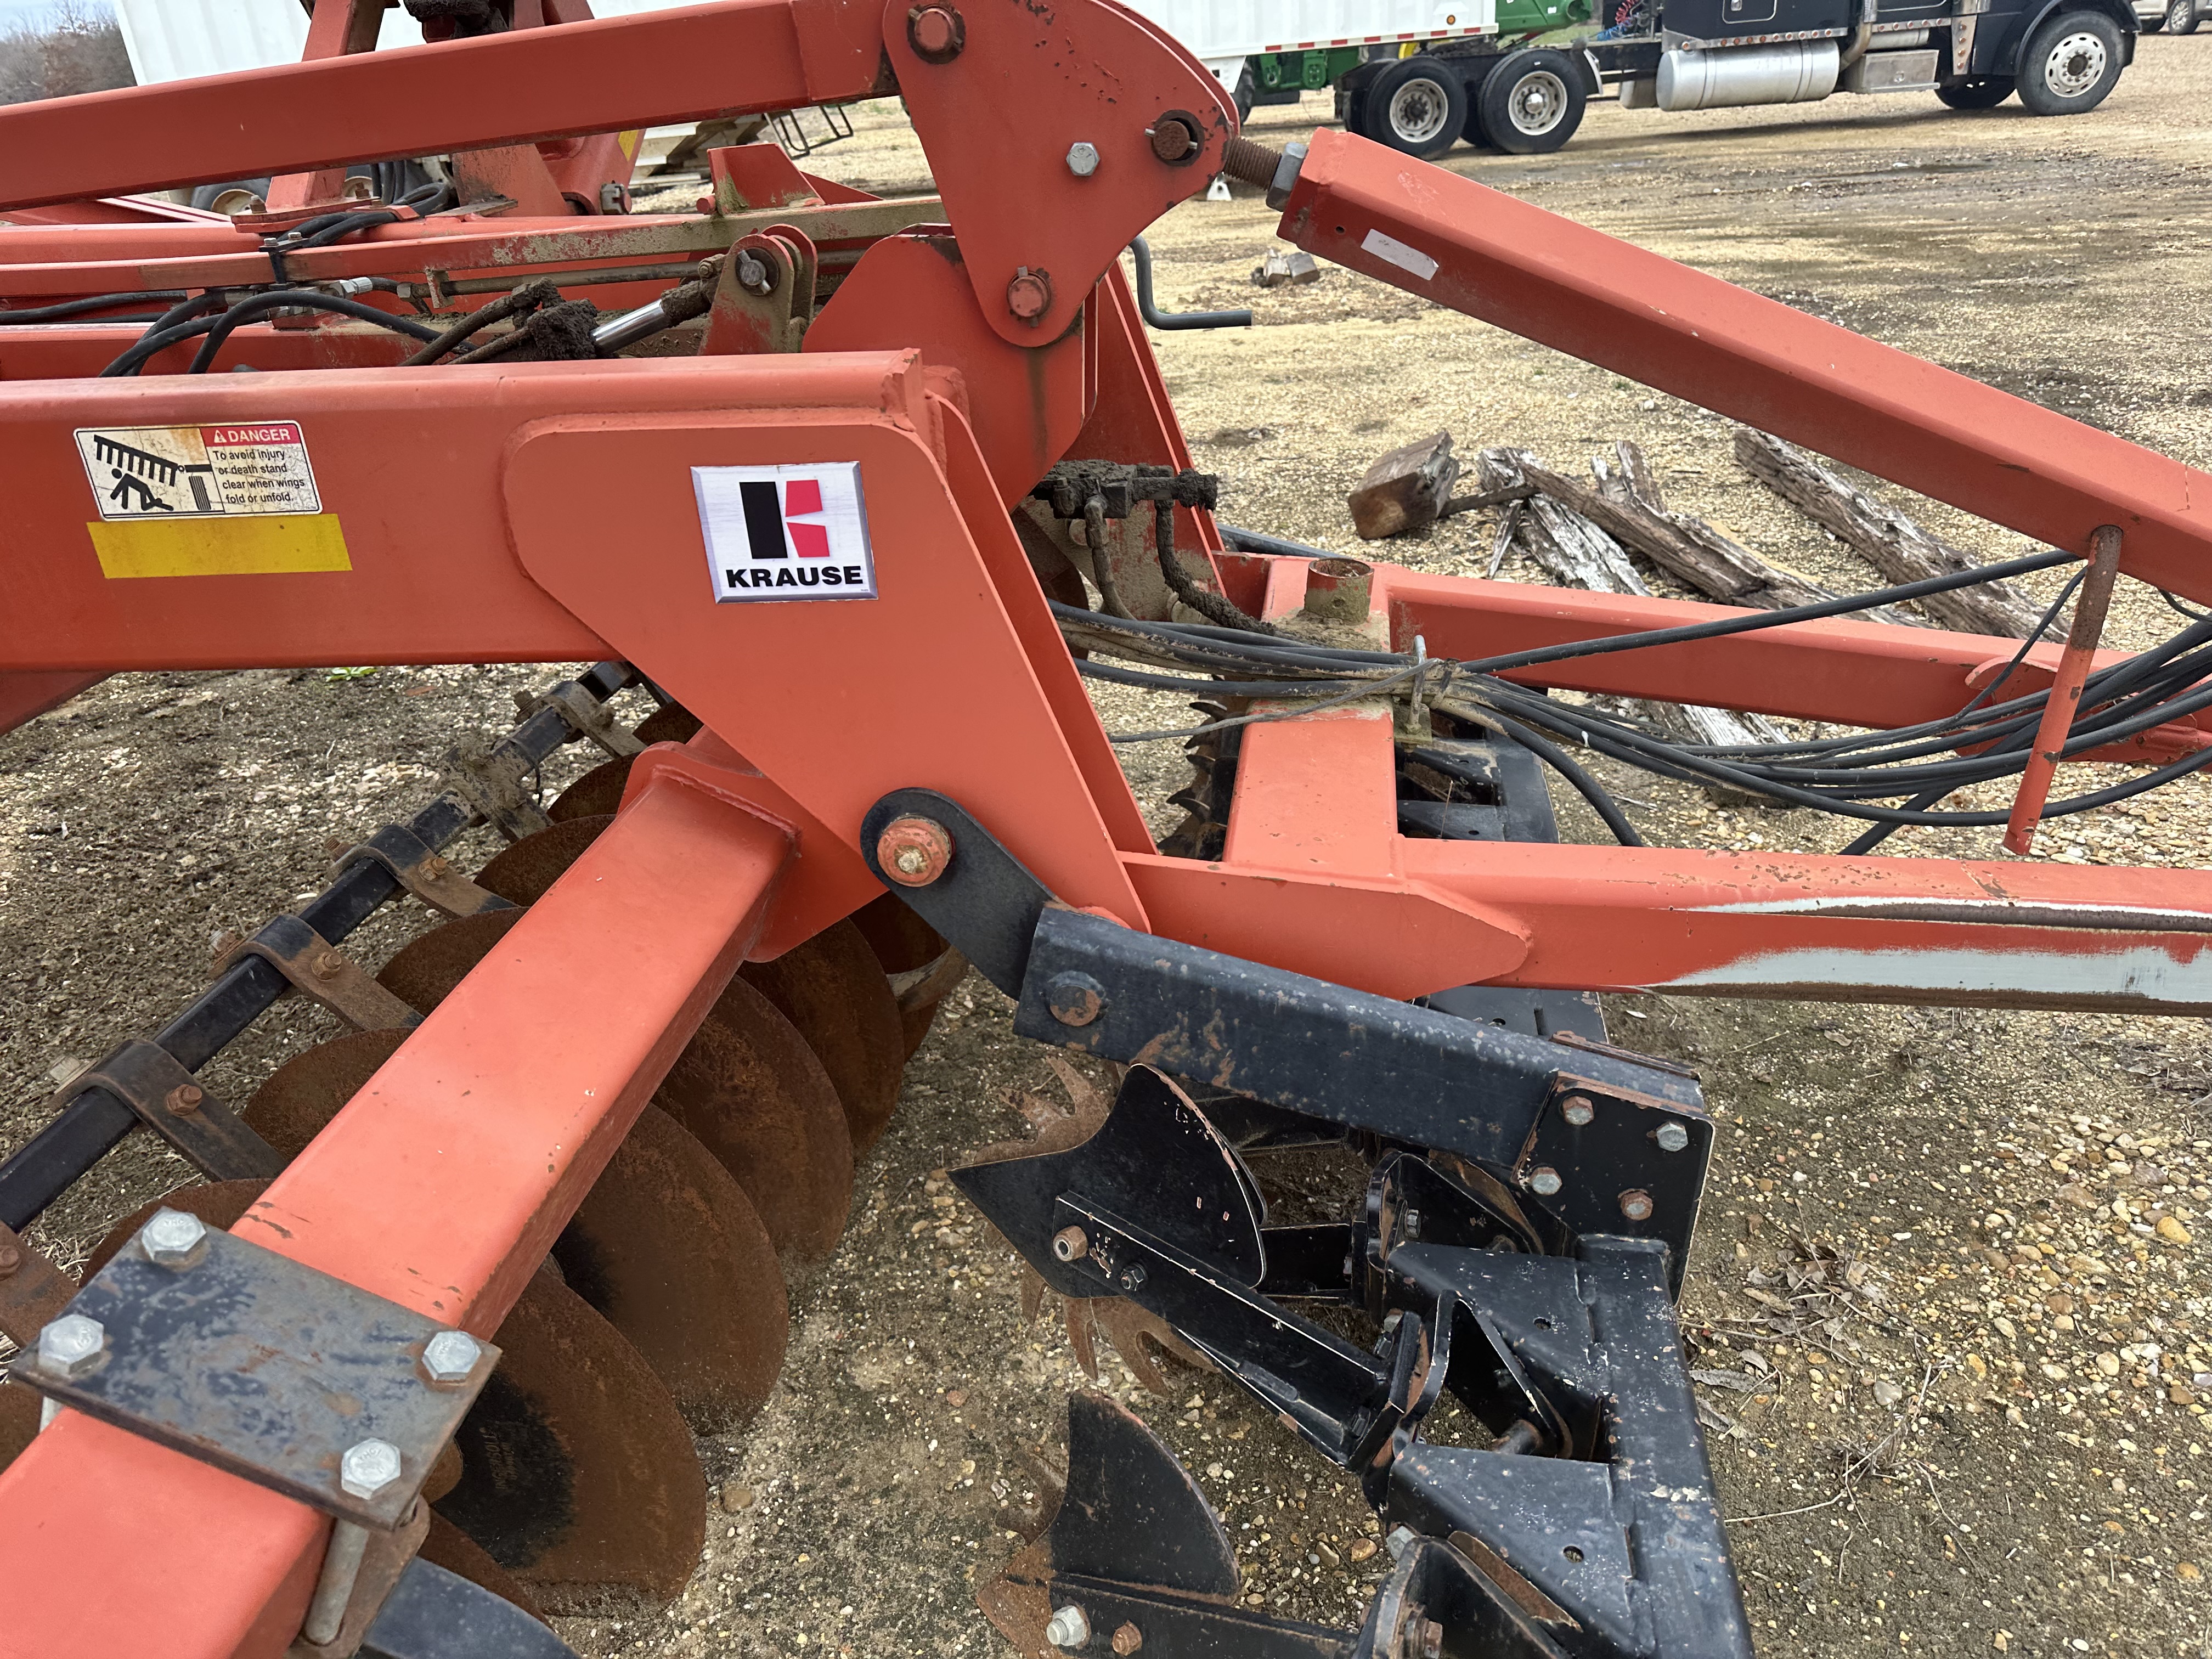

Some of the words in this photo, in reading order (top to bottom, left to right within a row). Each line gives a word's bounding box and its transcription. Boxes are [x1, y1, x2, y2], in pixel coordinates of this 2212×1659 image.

[227, 428, 291, 442] DANGER
[213, 450, 227, 460] To
[229, 449, 256, 460] avoid
[258, 449, 285, 461] injury
[231, 465, 258, 475] death
[261, 463, 287, 473] stand
[222, 480, 246, 489] clear
[247, 478, 274, 488] when
[276, 478, 305, 489] wings
[225, 494, 245, 504] fold
[260, 492, 294, 502] unfold.
[725, 566, 864, 588] KRAUSE
